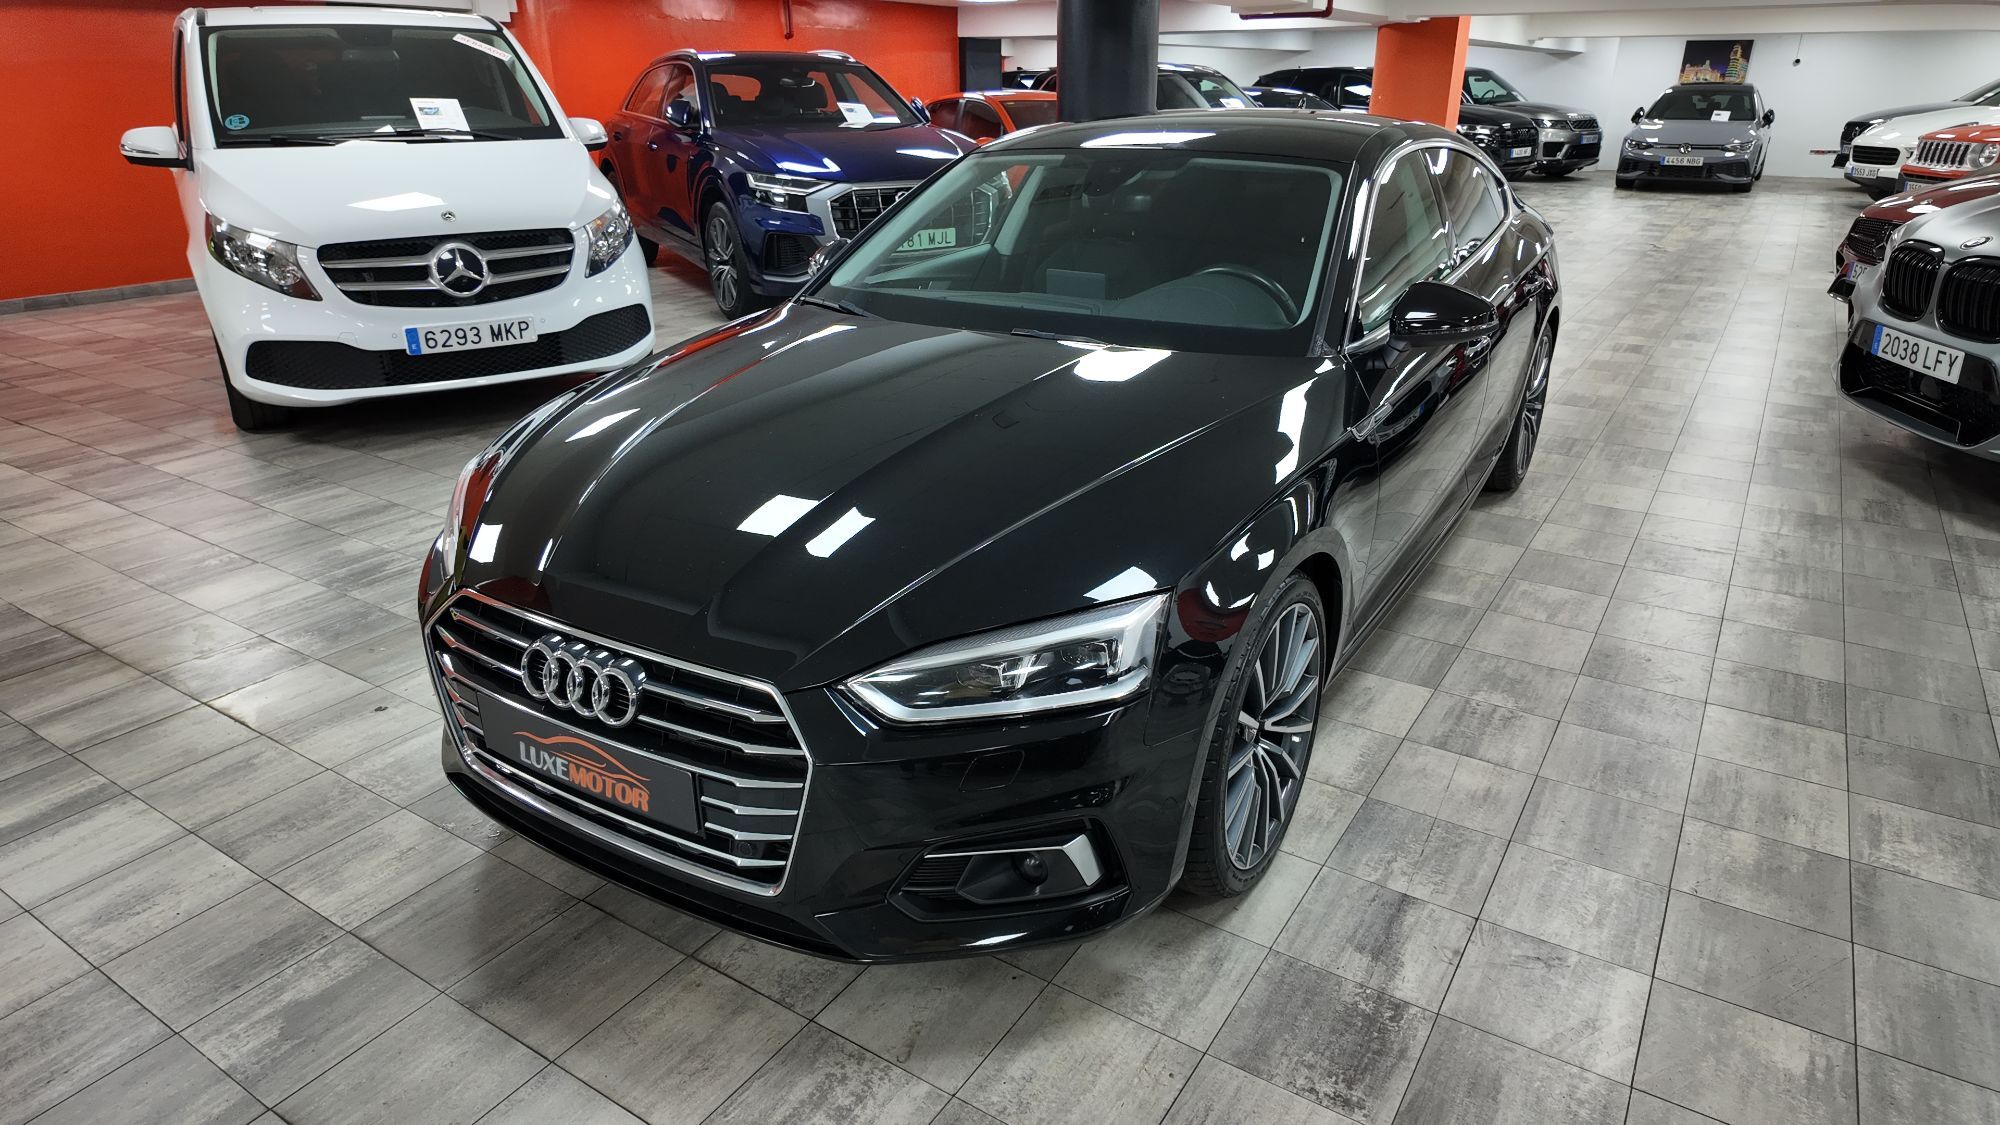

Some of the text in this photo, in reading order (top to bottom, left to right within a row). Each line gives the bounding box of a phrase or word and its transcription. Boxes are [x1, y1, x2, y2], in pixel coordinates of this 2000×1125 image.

[1666, 157, 1685, 165] 4456
[928, 231, 952, 246] MJL
[424, 320, 530, 349] 6293 MKP
[1881, 333, 1959, 377] 2038 LFY
[519, 740, 649, 813] LUXEMOTOR
